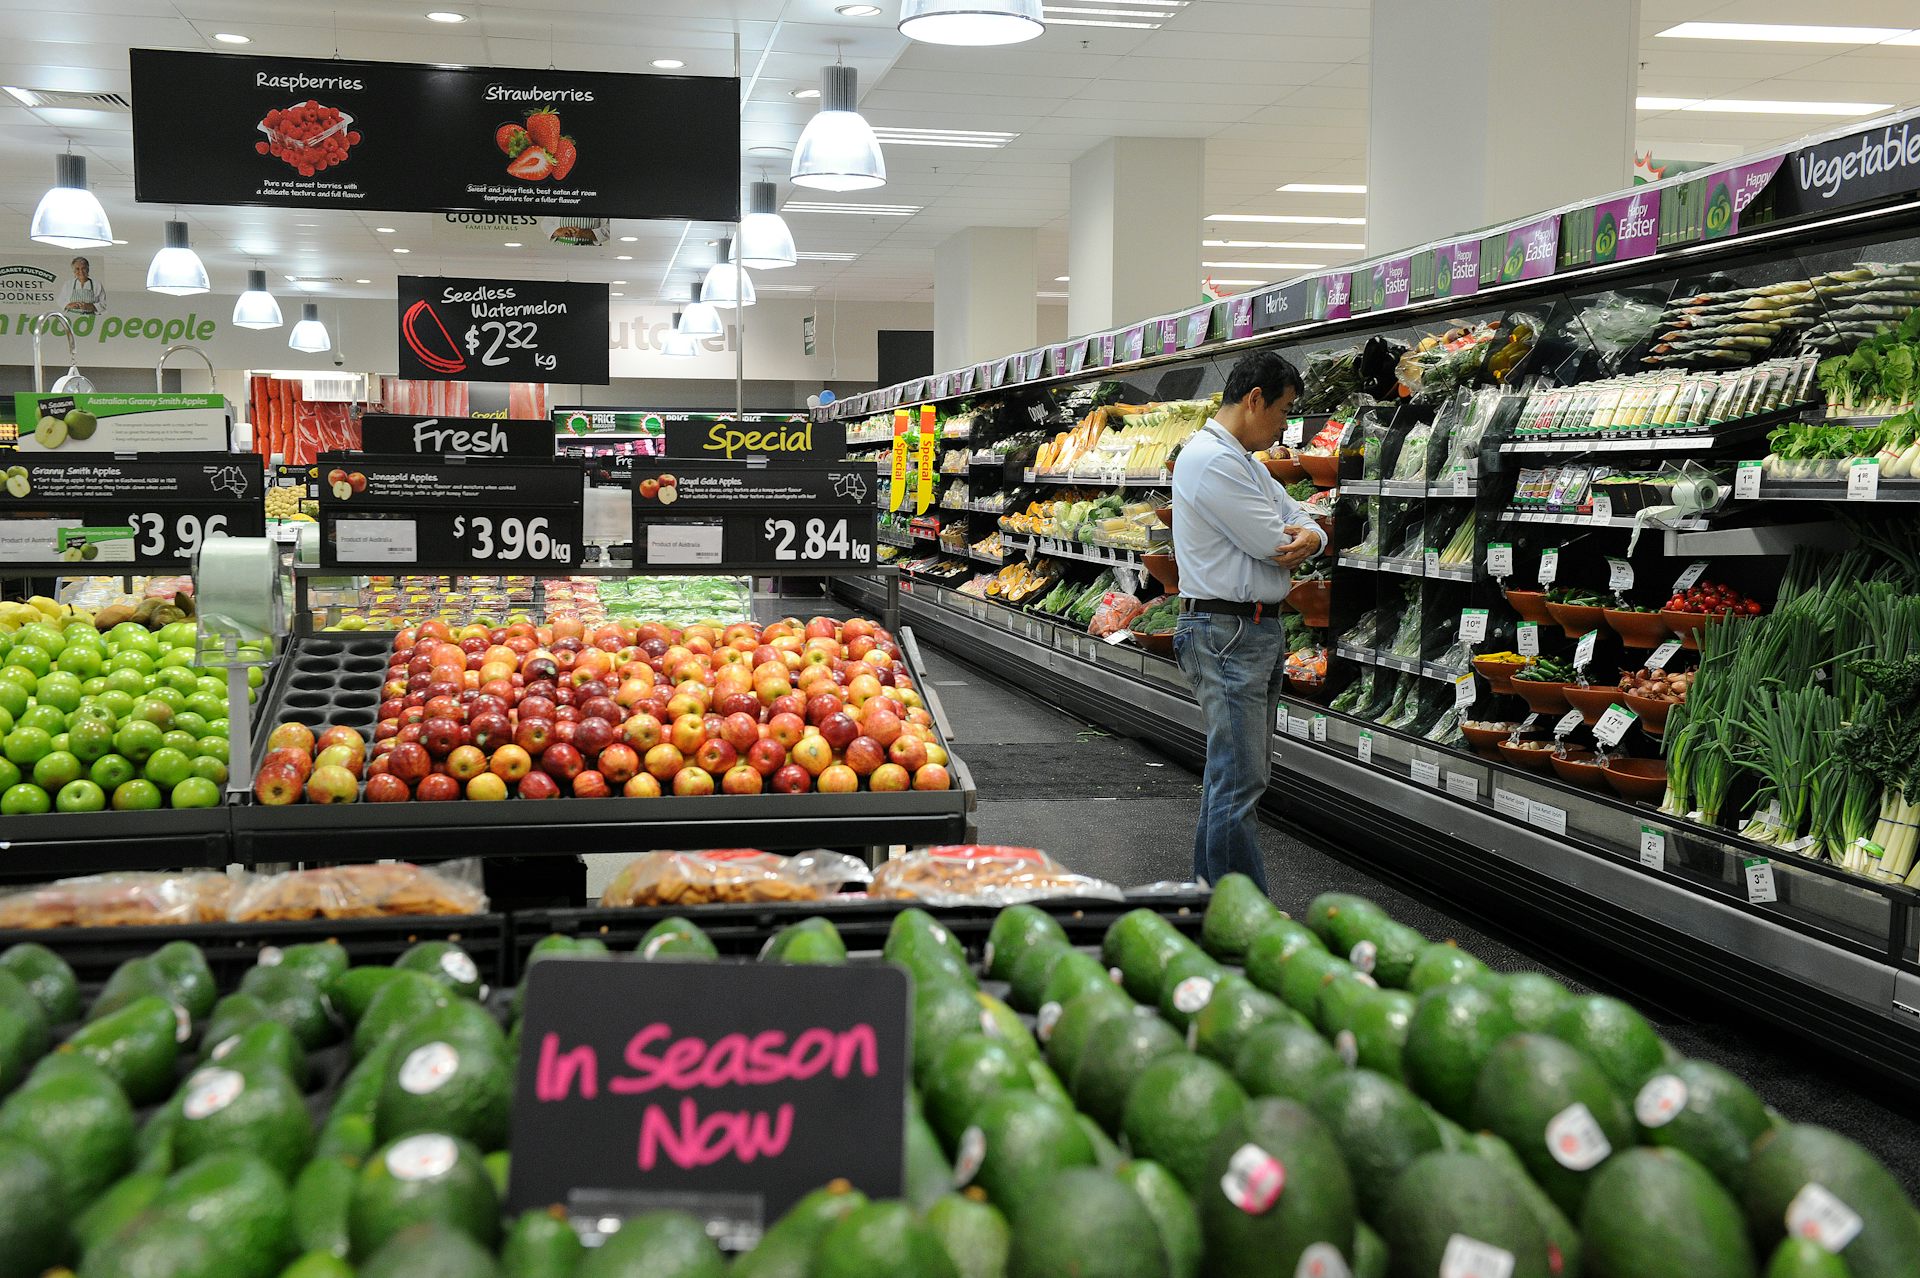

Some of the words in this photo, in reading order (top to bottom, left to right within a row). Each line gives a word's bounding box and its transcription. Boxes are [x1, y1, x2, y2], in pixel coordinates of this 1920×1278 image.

[256, 71, 363, 92] Raspberries
[485, 85, 594, 102] Strawberries
[1799, 124, 1920, 198] Vegetable
[263, 179, 280, 187] Pure
[317, 181, 343, 190] berries
[1746, 171, 1772, 188] Happy
[263, 188, 290, 196] delicate
[290, 189, 316, 197] texture
[317, 190, 330, 198] and
[331, 190, 342, 198] full
[342, 191, 366, 199] flavour
[466, 185, 487, 193] Sweet
[501, 187, 517, 195] juicy
[446, 213, 538, 225] GOODNESS
[1627, 203, 1648, 218] Happy
[1535, 229, 1553, 242] Happy
[1618, 216, 1656, 241] Easter
[1456, 250, 1473, 262] Happy
[1525, 239, 1556, 263] Easter
[1389, 266, 1404, 278] Happy
[1452, 261, 1478, 280] Easter
[0, 280, 44, 289] HONEST
[1385, 277, 1409, 295] Easter
[441, 286, 516, 304] Seedless
[471, 300, 568, 319] Watermelon
[1265, 295, 1289, 315] Herbs
[1233, 311, 1251, 327] Easter
[98, 312, 216, 345] people
[534, 352, 557, 371] kg
[88, 397, 127, 405] Australian
[128, 397, 157, 407] Granny
[158, 397, 181, 405] Smith
[181, 397, 208, 407] Apples
[592, 413, 616, 424] PRICE
[413, 418, 509, 453] Fresh
[702, 422, 813, 460] Special
[894, 442, 906, 480] Special
[921, 440, 932, 481] Special
[32, 467, 65, 479] Granny
[66, 467, 91, 475] Smith
[92, 466, 122, 478] Apples
[368, 473, 408, 484] Jonagold
[410, 473, 439, 484] Apples
[679, 477, 700, 488] Royal
[700, 477, 718, 486] Gala
[718, 477, 743, 488] Apples
[453, 514, 550, 560] $3.96
[551, 538, 571, 563] kg
[764, 517, 849, 561] $2.84
[851, 539, 871, 564] kg
[535, 1030, 599, 1103] In
[607, 1021, 880, 1095] Season
[637, 1096, 796, 1173] Now
